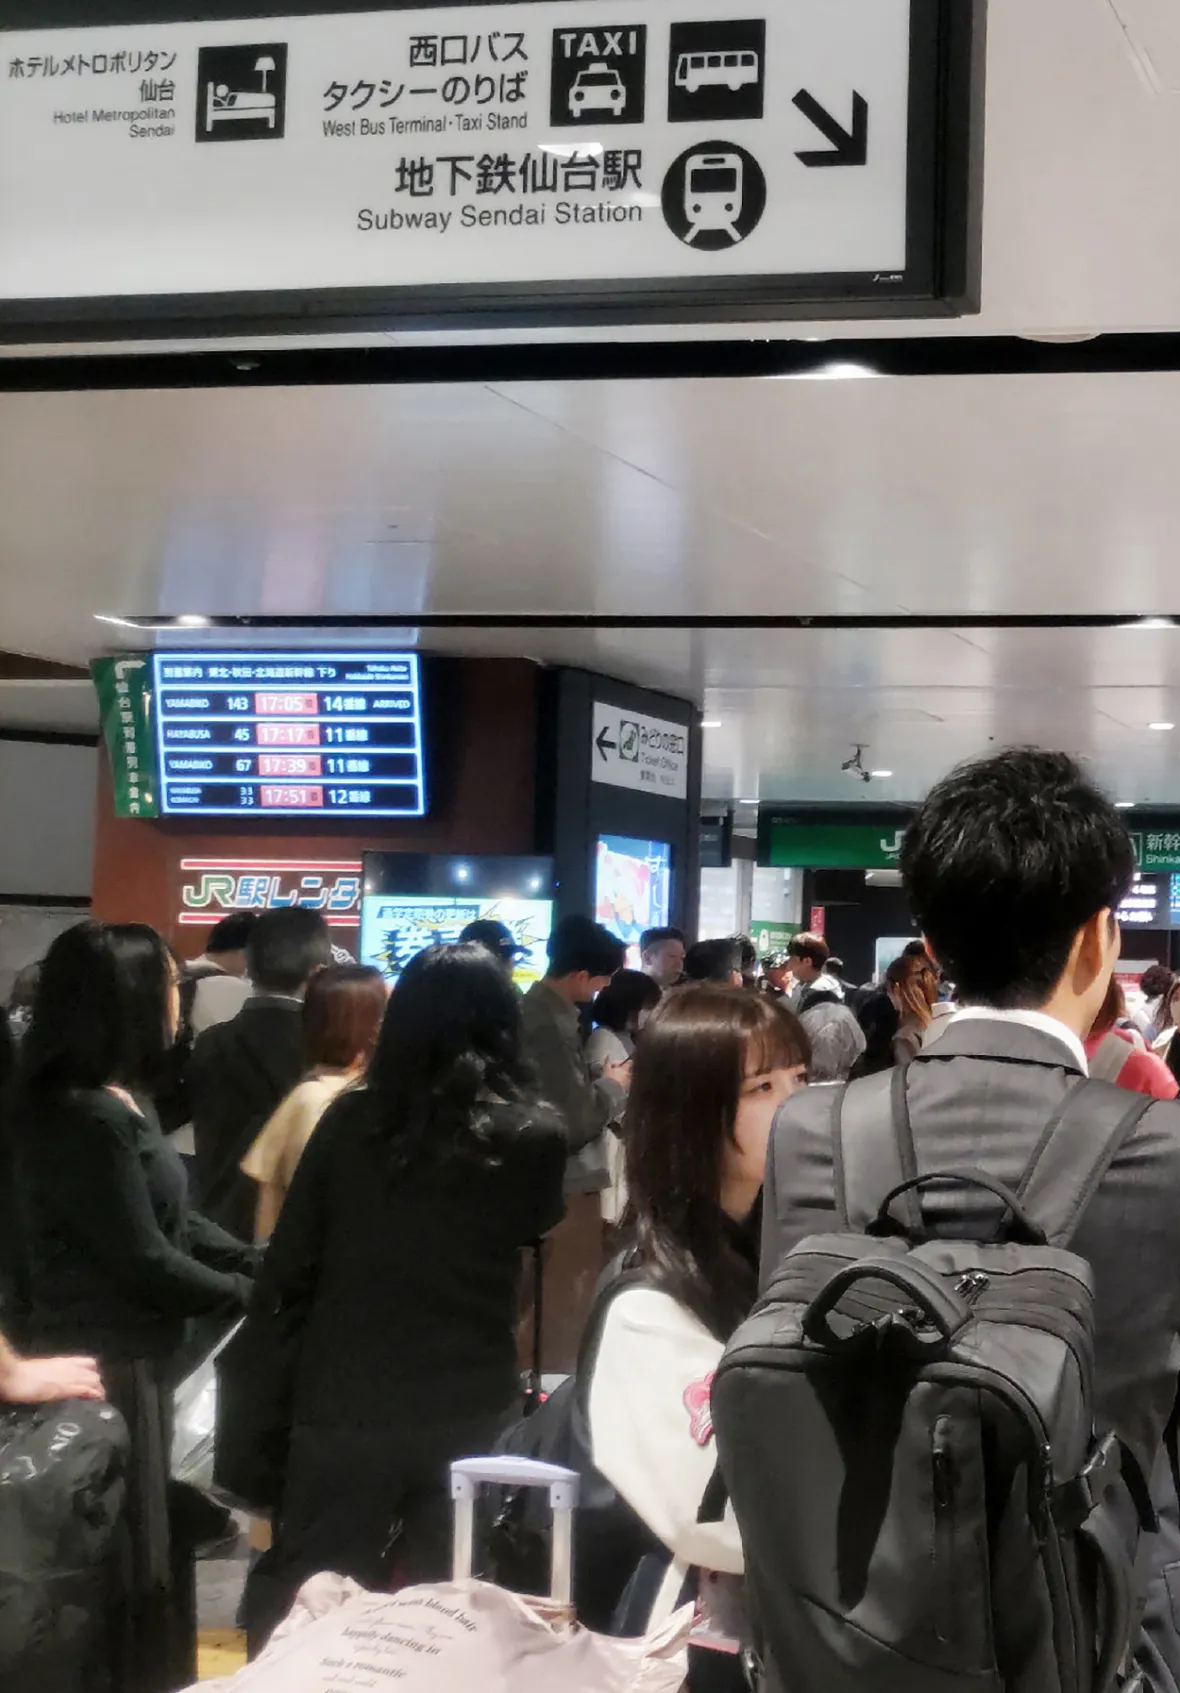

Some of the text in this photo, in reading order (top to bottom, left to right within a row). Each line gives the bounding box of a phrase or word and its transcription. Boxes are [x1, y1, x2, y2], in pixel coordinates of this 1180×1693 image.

[409, 32, 528, 67] 西口バス
[560, 31, 638, 58] TAXI
[9, 51, 177, 78] ホテルメトロポリタン
[138, 78, 175, 102] 仙台
[323, 70, 528, 111] タクシーのりば
[53, 107, 175, 124] Hotel Metropolitan
[322, 119, 356, 137] West
[360, 118, 385, 135] Bus
[486, 112, 527, 130] Stand
[129, 124, 175, 138] Sendai
[394, 150, 642, 196] 地下鉄仙台駅
[357, 201, 642, 233] Subway Sendai Station
[227, 697, 248, 710] 143
[262, 696, 303, 711] 17:05
[234, 727, 251, 741] 45
[262, 727, 304, 742] 17:17
[641, 726, 684, 754] みどりの窓口
[236, 759, 252, 772] 67
[263, 759, 306, 773] 17:39
[265, 789, 306, 804] 17:51
[183, 874, 361, 910] JR駅レンタ
